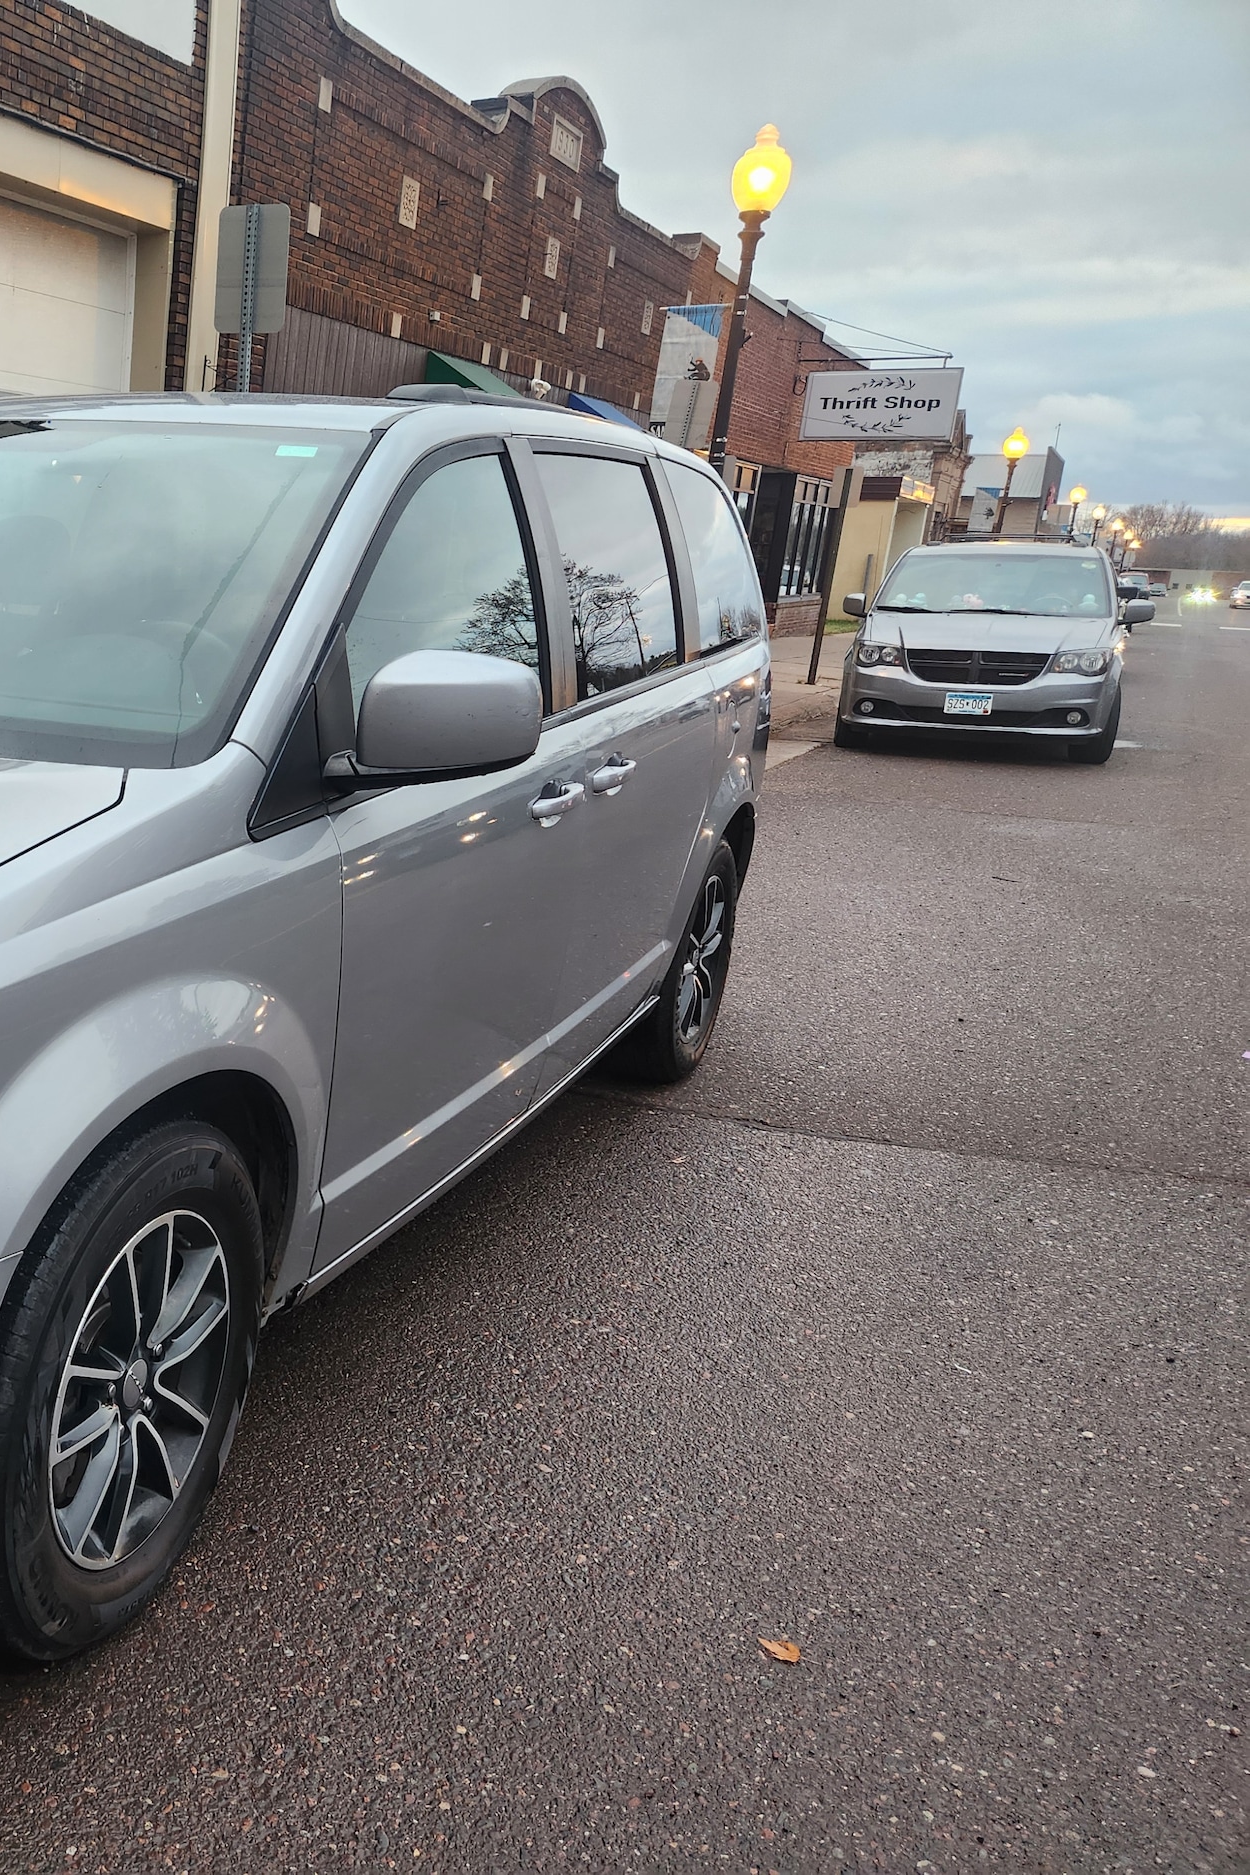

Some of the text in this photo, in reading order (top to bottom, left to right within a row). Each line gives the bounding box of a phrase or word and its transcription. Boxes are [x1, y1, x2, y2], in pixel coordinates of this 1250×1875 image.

[554, 127, 576, 159] 1930
[820, 396, 941, 412] Thrift Shop
[170, 1164, 199, 1183] 102H
